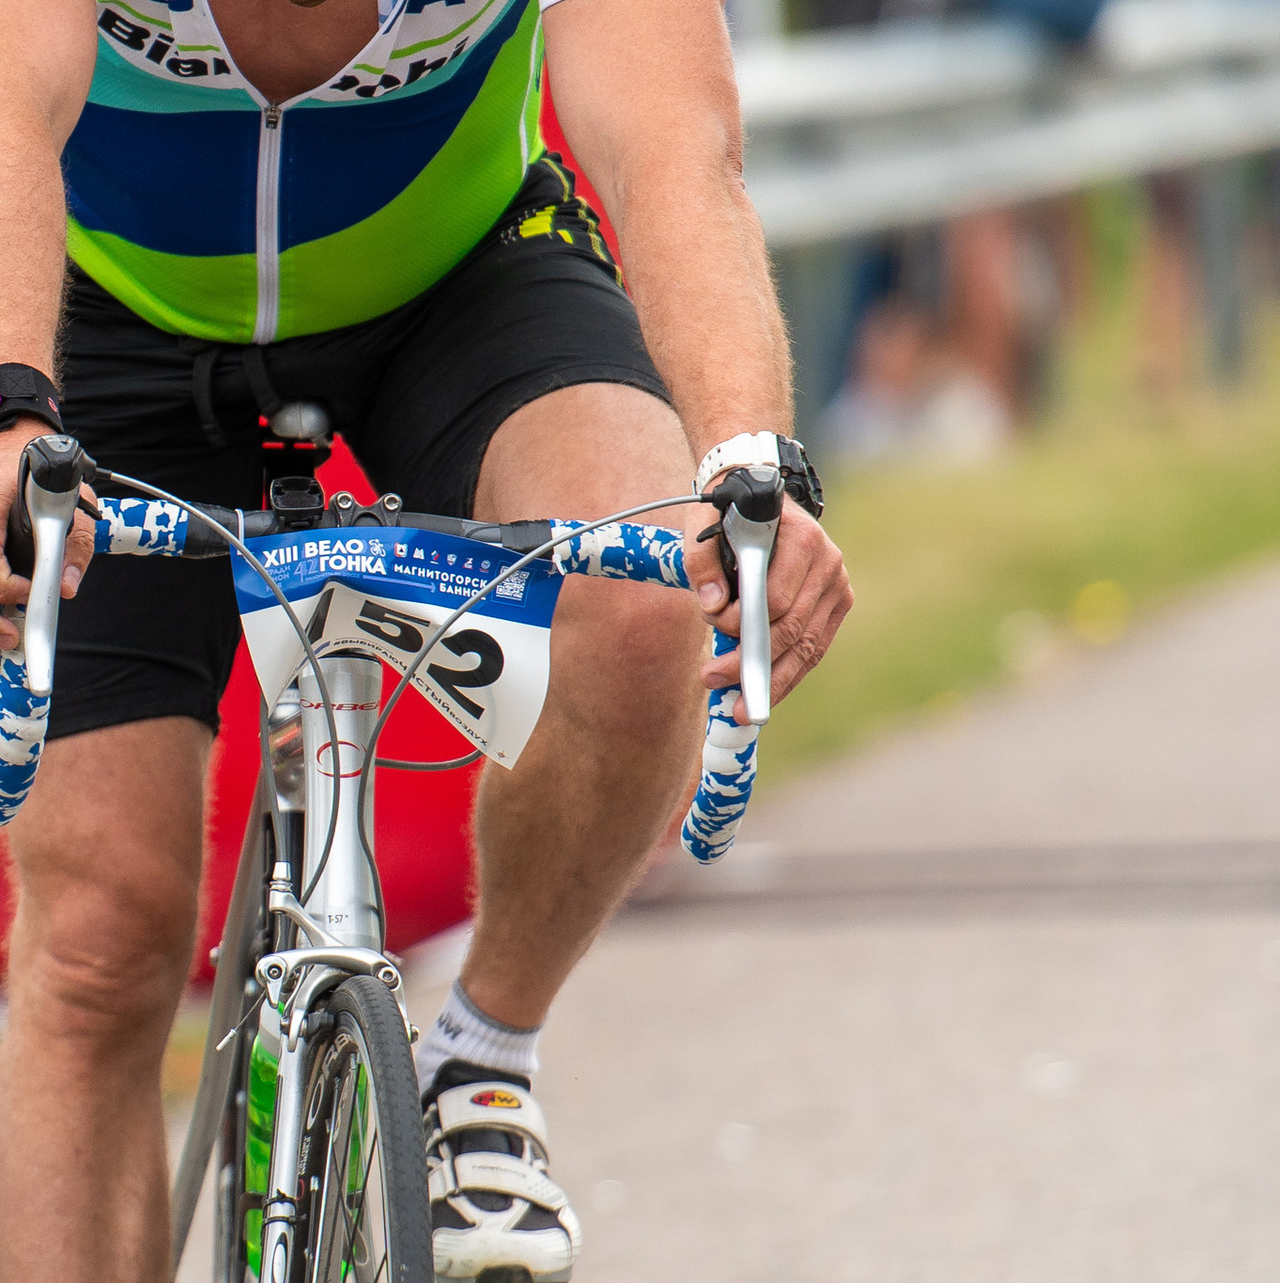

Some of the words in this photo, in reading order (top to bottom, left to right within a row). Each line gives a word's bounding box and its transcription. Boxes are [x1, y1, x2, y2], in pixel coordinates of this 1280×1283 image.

[304, 538, 364, 559] ВЕЛО
[319, 555, 387, 575] ГОНКА
[393, 563, 489, 589] МАГНИТОГОРСК
[439, 582, 487, 600] БАННО
